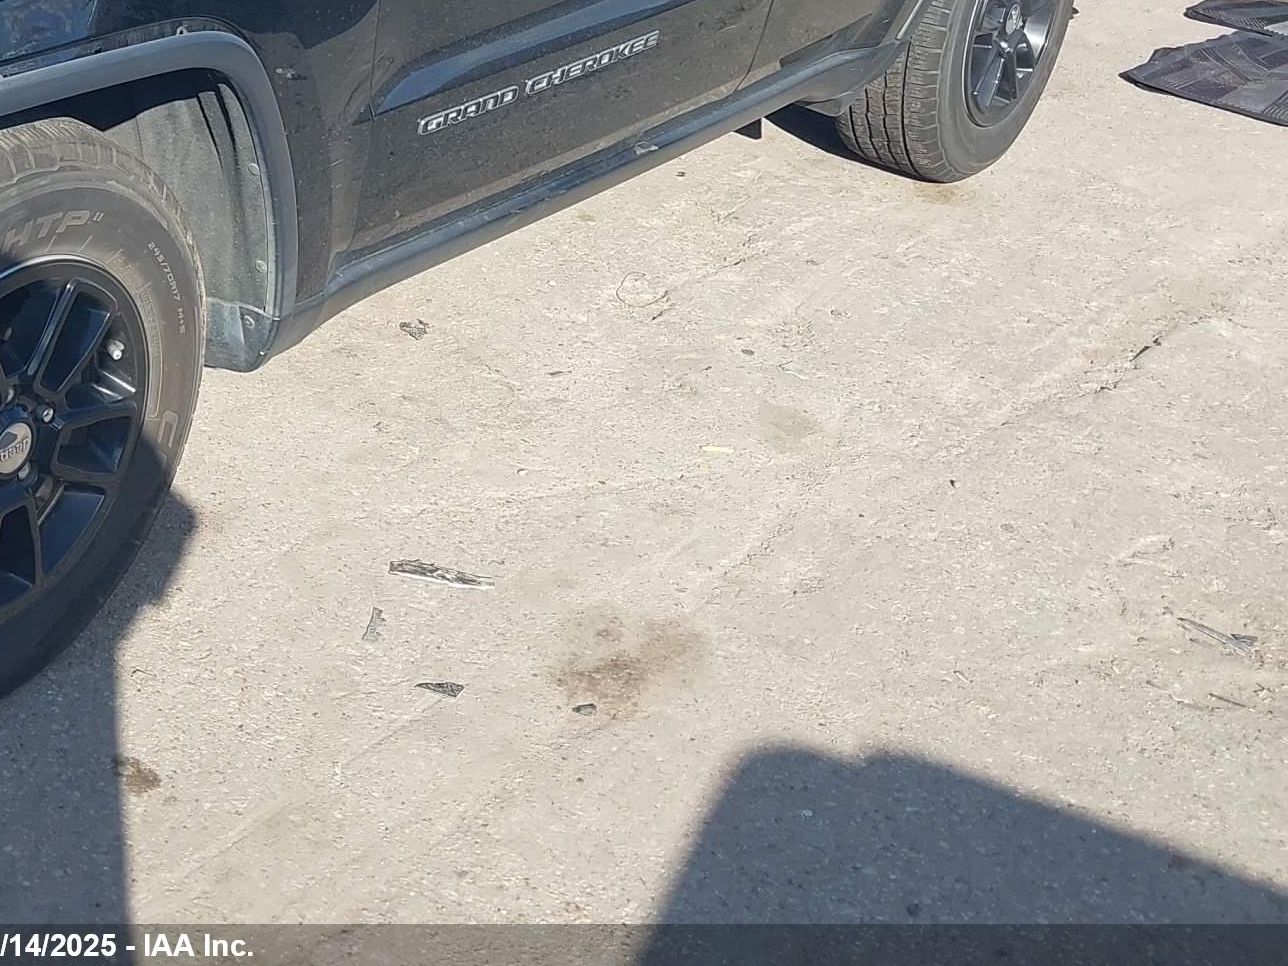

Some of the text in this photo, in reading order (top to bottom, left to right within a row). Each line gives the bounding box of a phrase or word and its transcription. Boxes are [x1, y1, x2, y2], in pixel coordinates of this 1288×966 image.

[417, 30, 660, 135] GRAND CHEROKEE
[147, 241, 182, 303] 245/70R17
